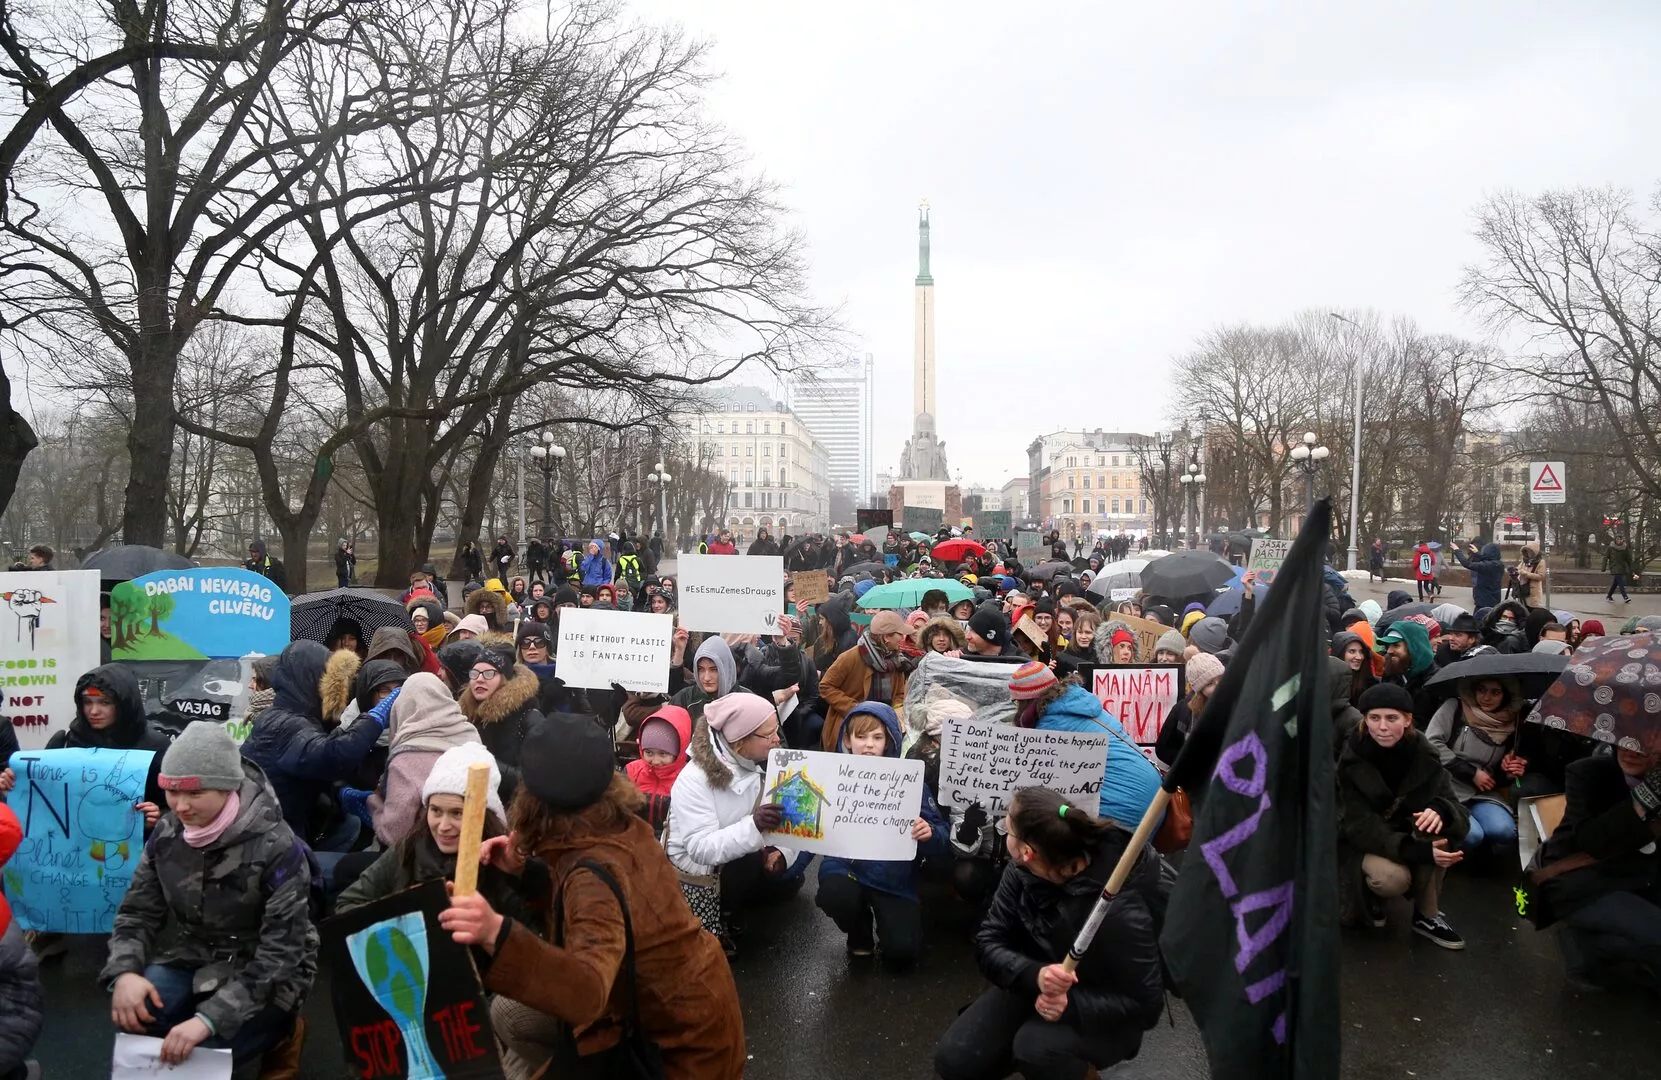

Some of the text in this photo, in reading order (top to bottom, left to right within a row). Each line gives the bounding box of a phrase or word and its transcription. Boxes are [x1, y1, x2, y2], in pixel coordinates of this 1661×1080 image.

[1252, 559, 1280, 569] TAGA
[145, 577, 194, 596] DABAI
[685, 585, 777, 597] #EsEsmuZemesDraugs
[209, 599, 274, 620] CILVĒKU
[565, 633, 666, 647] LIFE WITHOUT PLASTIC
[42, 657, 57, 668] IS
[592, 650, 654, 663] FANTASTIC!
[1096, 669, 1170, 696] MAINĀM
[9, 695, 45, 707] NOT
[950, 735, 960, 745] I
[965, 740, 989, 750] want
[990, 744, 1009, 755] you
[1014, 743, 1025, 754] to
[967, 725, 993, 738] Don't
[996, 732, 1020, 742] want
[1020, 736, 1042, 748] you
[1071, 736, 1107, 750] hopeful.
[948, 748, 1102, 774] I want you to feel the fear
[81, 766, 98, 784] is
[839, 763, 919, 790] We can only put
[947, 761, 956, 770] I
[956, 763, 984, 776] feel
[990, 767, 1021, 783] every
[837, 782, 906, 801] out the fire
[946, 775, 969, 787] And
[972, 777, 999, 791] then
[1069, 784, 1081, 794] to
[833, 813, 915, 835] policies change
[15, 837, 126, 871] Planet B
[30, 870, 131, 888] CHANGE LIFEST
[351, 1001, 487, 1080] STOP THE
